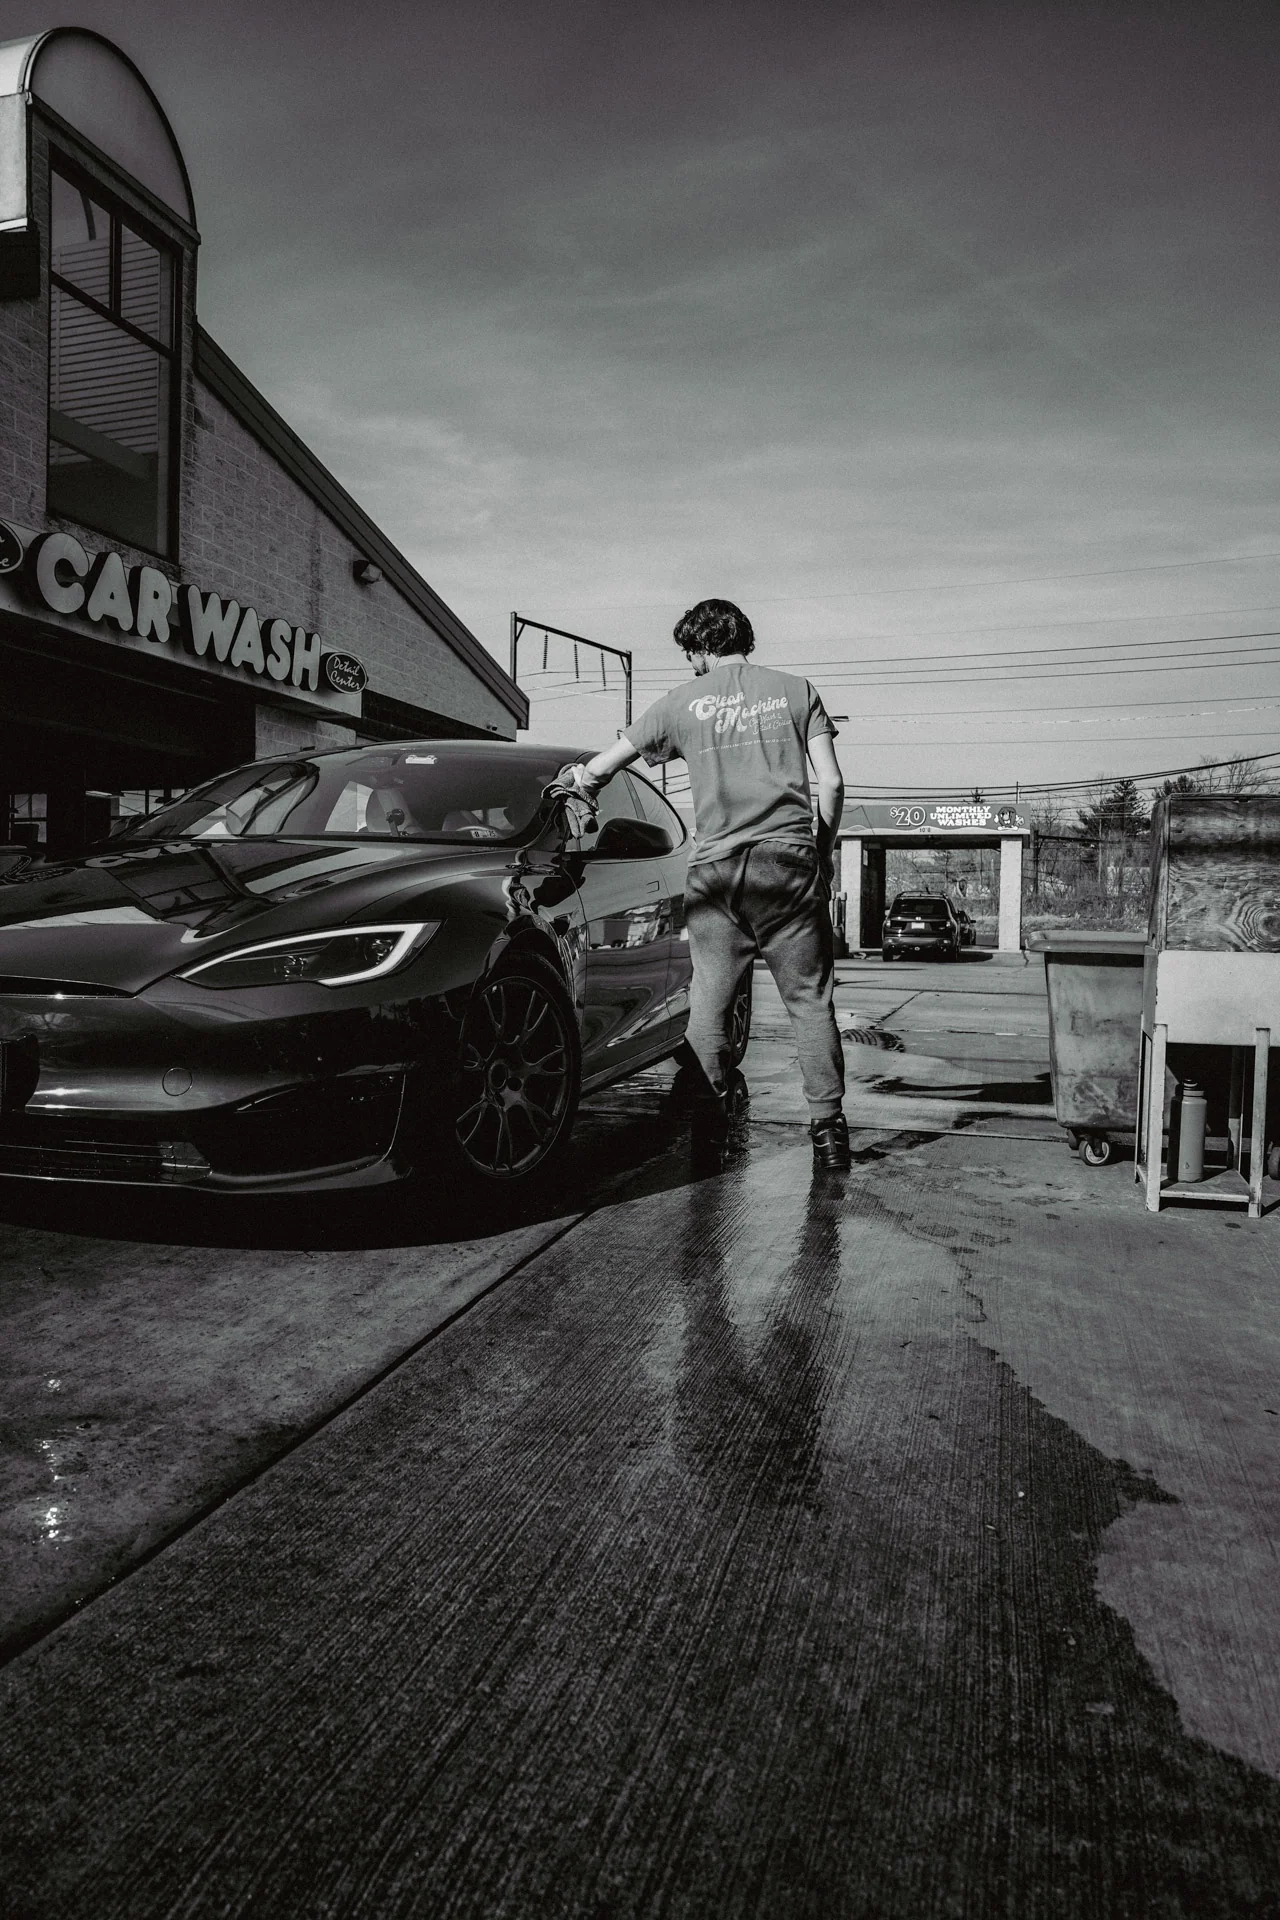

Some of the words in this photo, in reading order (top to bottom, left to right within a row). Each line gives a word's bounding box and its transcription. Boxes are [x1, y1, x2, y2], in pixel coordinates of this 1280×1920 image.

[36, 532, 173, 643] CAR
[187, 584, 321, 692] WASH
[333, 656, 360, 676] Detail
[330, 670, 360, 690] Center
[688, 691, 746, 721] Clean
[714, 696, 789, 734] Machine
[890, 806, 926, 826] $20
